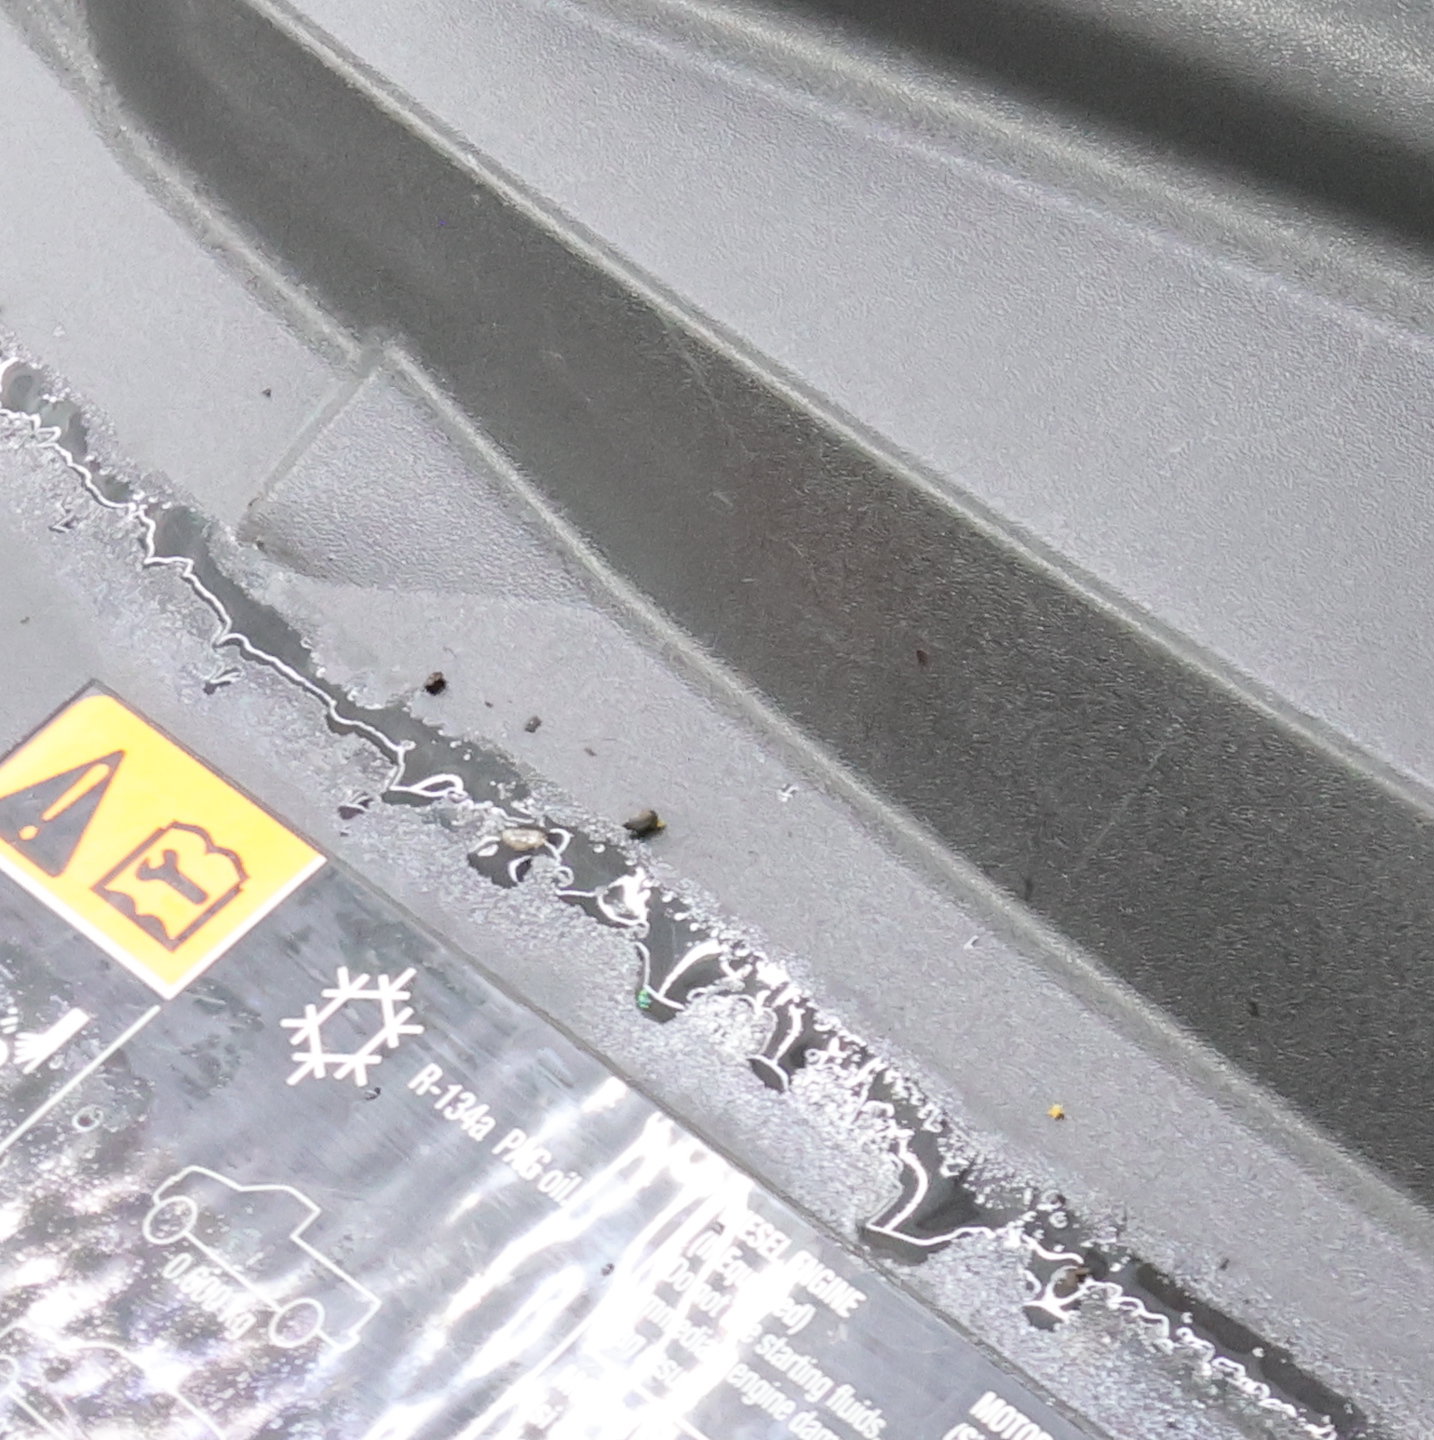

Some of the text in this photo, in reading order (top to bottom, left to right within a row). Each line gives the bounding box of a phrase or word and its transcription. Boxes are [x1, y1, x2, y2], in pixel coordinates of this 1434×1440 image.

[407, 1063, 495, 1141] R-134a
[492, 1128, 552, 1182] PAG
[726, 1363, 796, 1421] engine
[754, 1333, 834, 1404] starting
